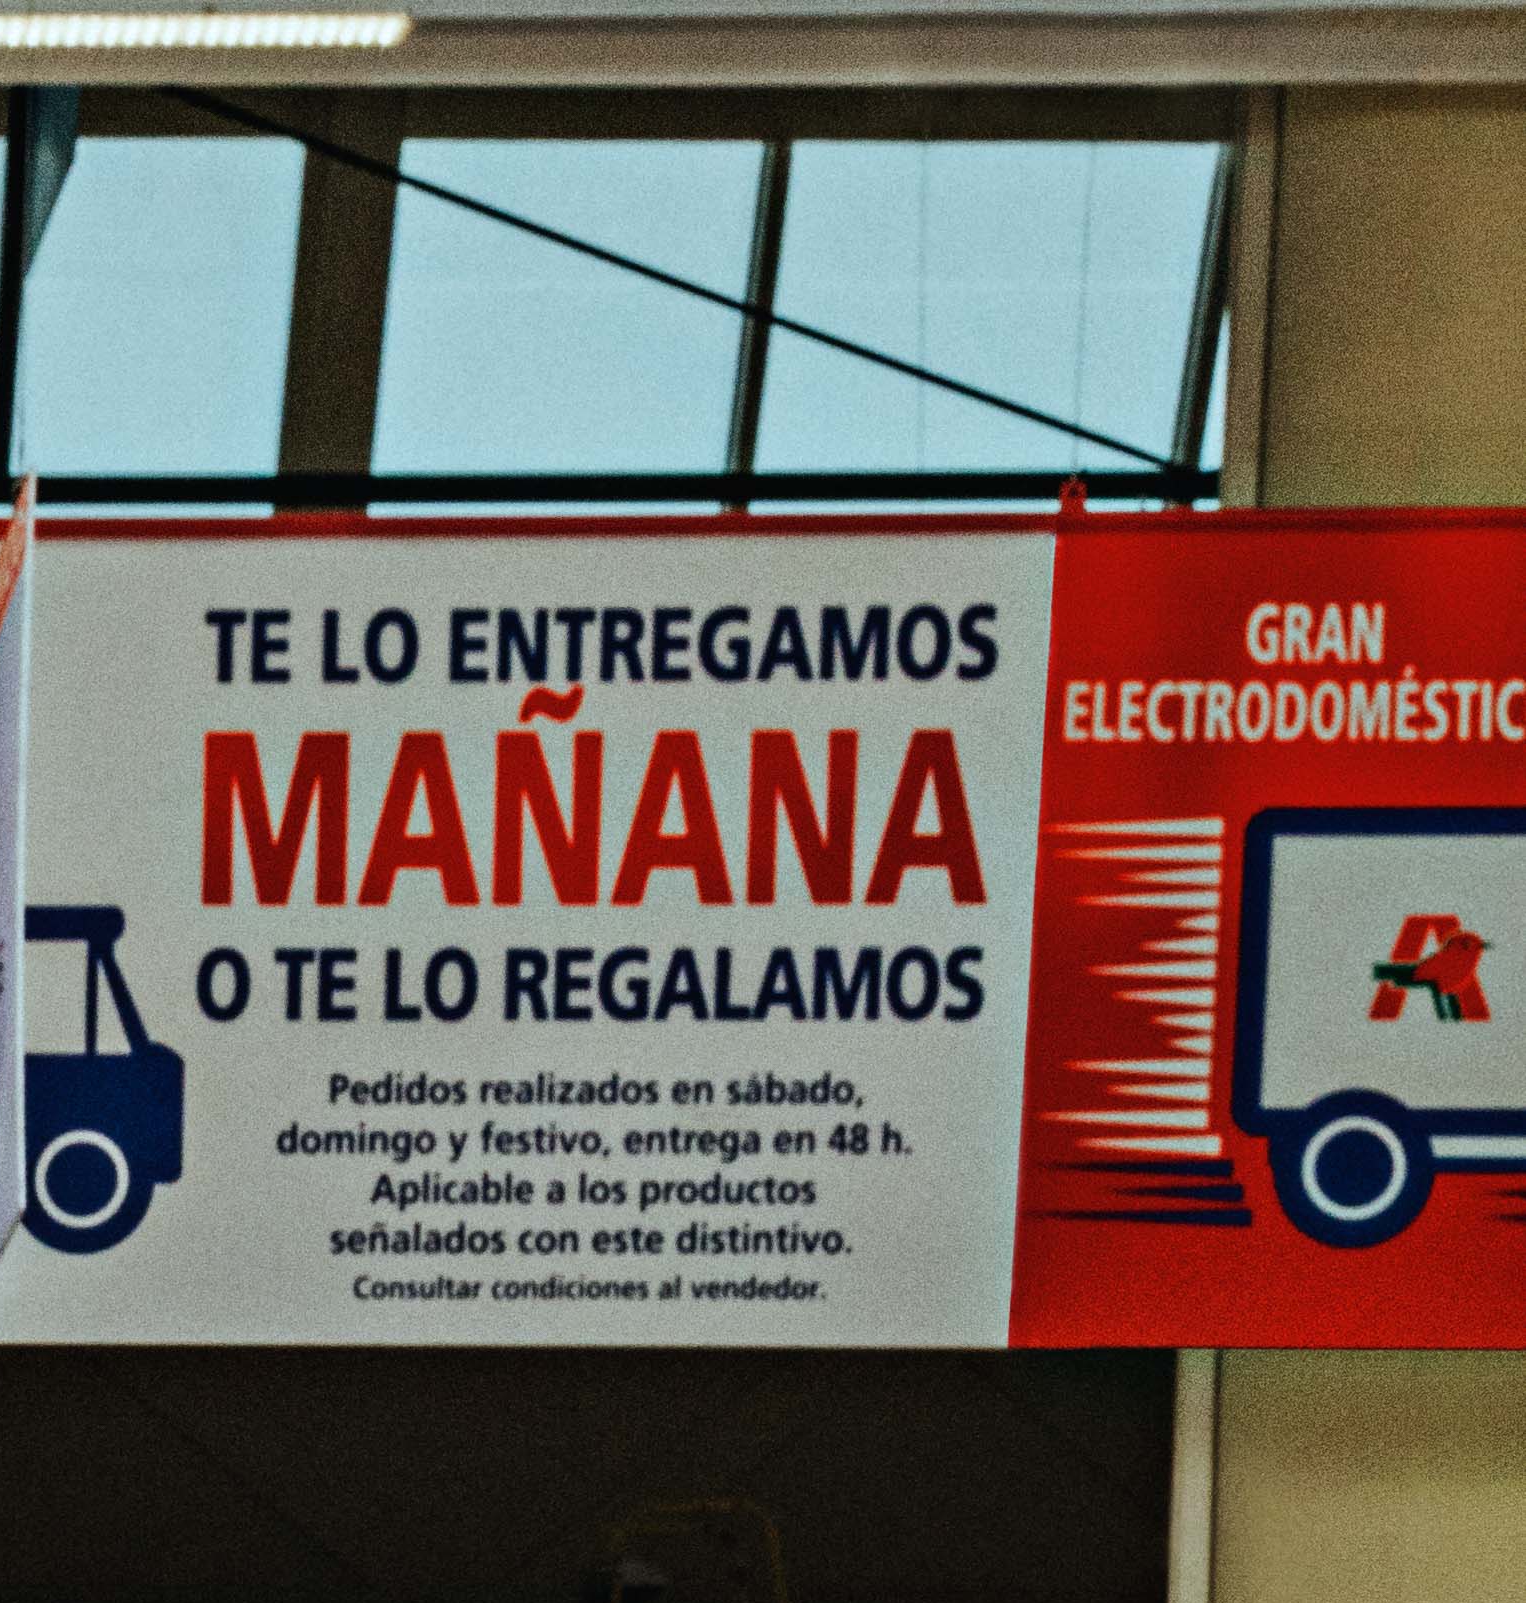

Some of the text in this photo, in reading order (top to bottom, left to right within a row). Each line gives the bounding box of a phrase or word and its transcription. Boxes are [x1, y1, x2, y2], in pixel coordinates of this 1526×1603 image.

[205, 604, 999, 684] TE LO ENTREGAMOS
[1247, 602, 1386, 666] GRAN
[1063, 667, 1526, 743] ELECTRODOMÉSTIC
[202, 683, 987, 906] MAÑANA
[196, 947, 985, 1023] O TE LO REGALAMOS
[328, 1071, 864, 1110] Pedidos realizados en sábado,
[276, 1123, 911, 1161] domingo y festivo, entrega en 48 h.
[371, 1174, 816, 1209] Aplicable a los productos
[330, 1223, 852, 1257] señalados con este distintivo.
[353, 1275, 826, 1302] Consultar condiciones al vendedor.
